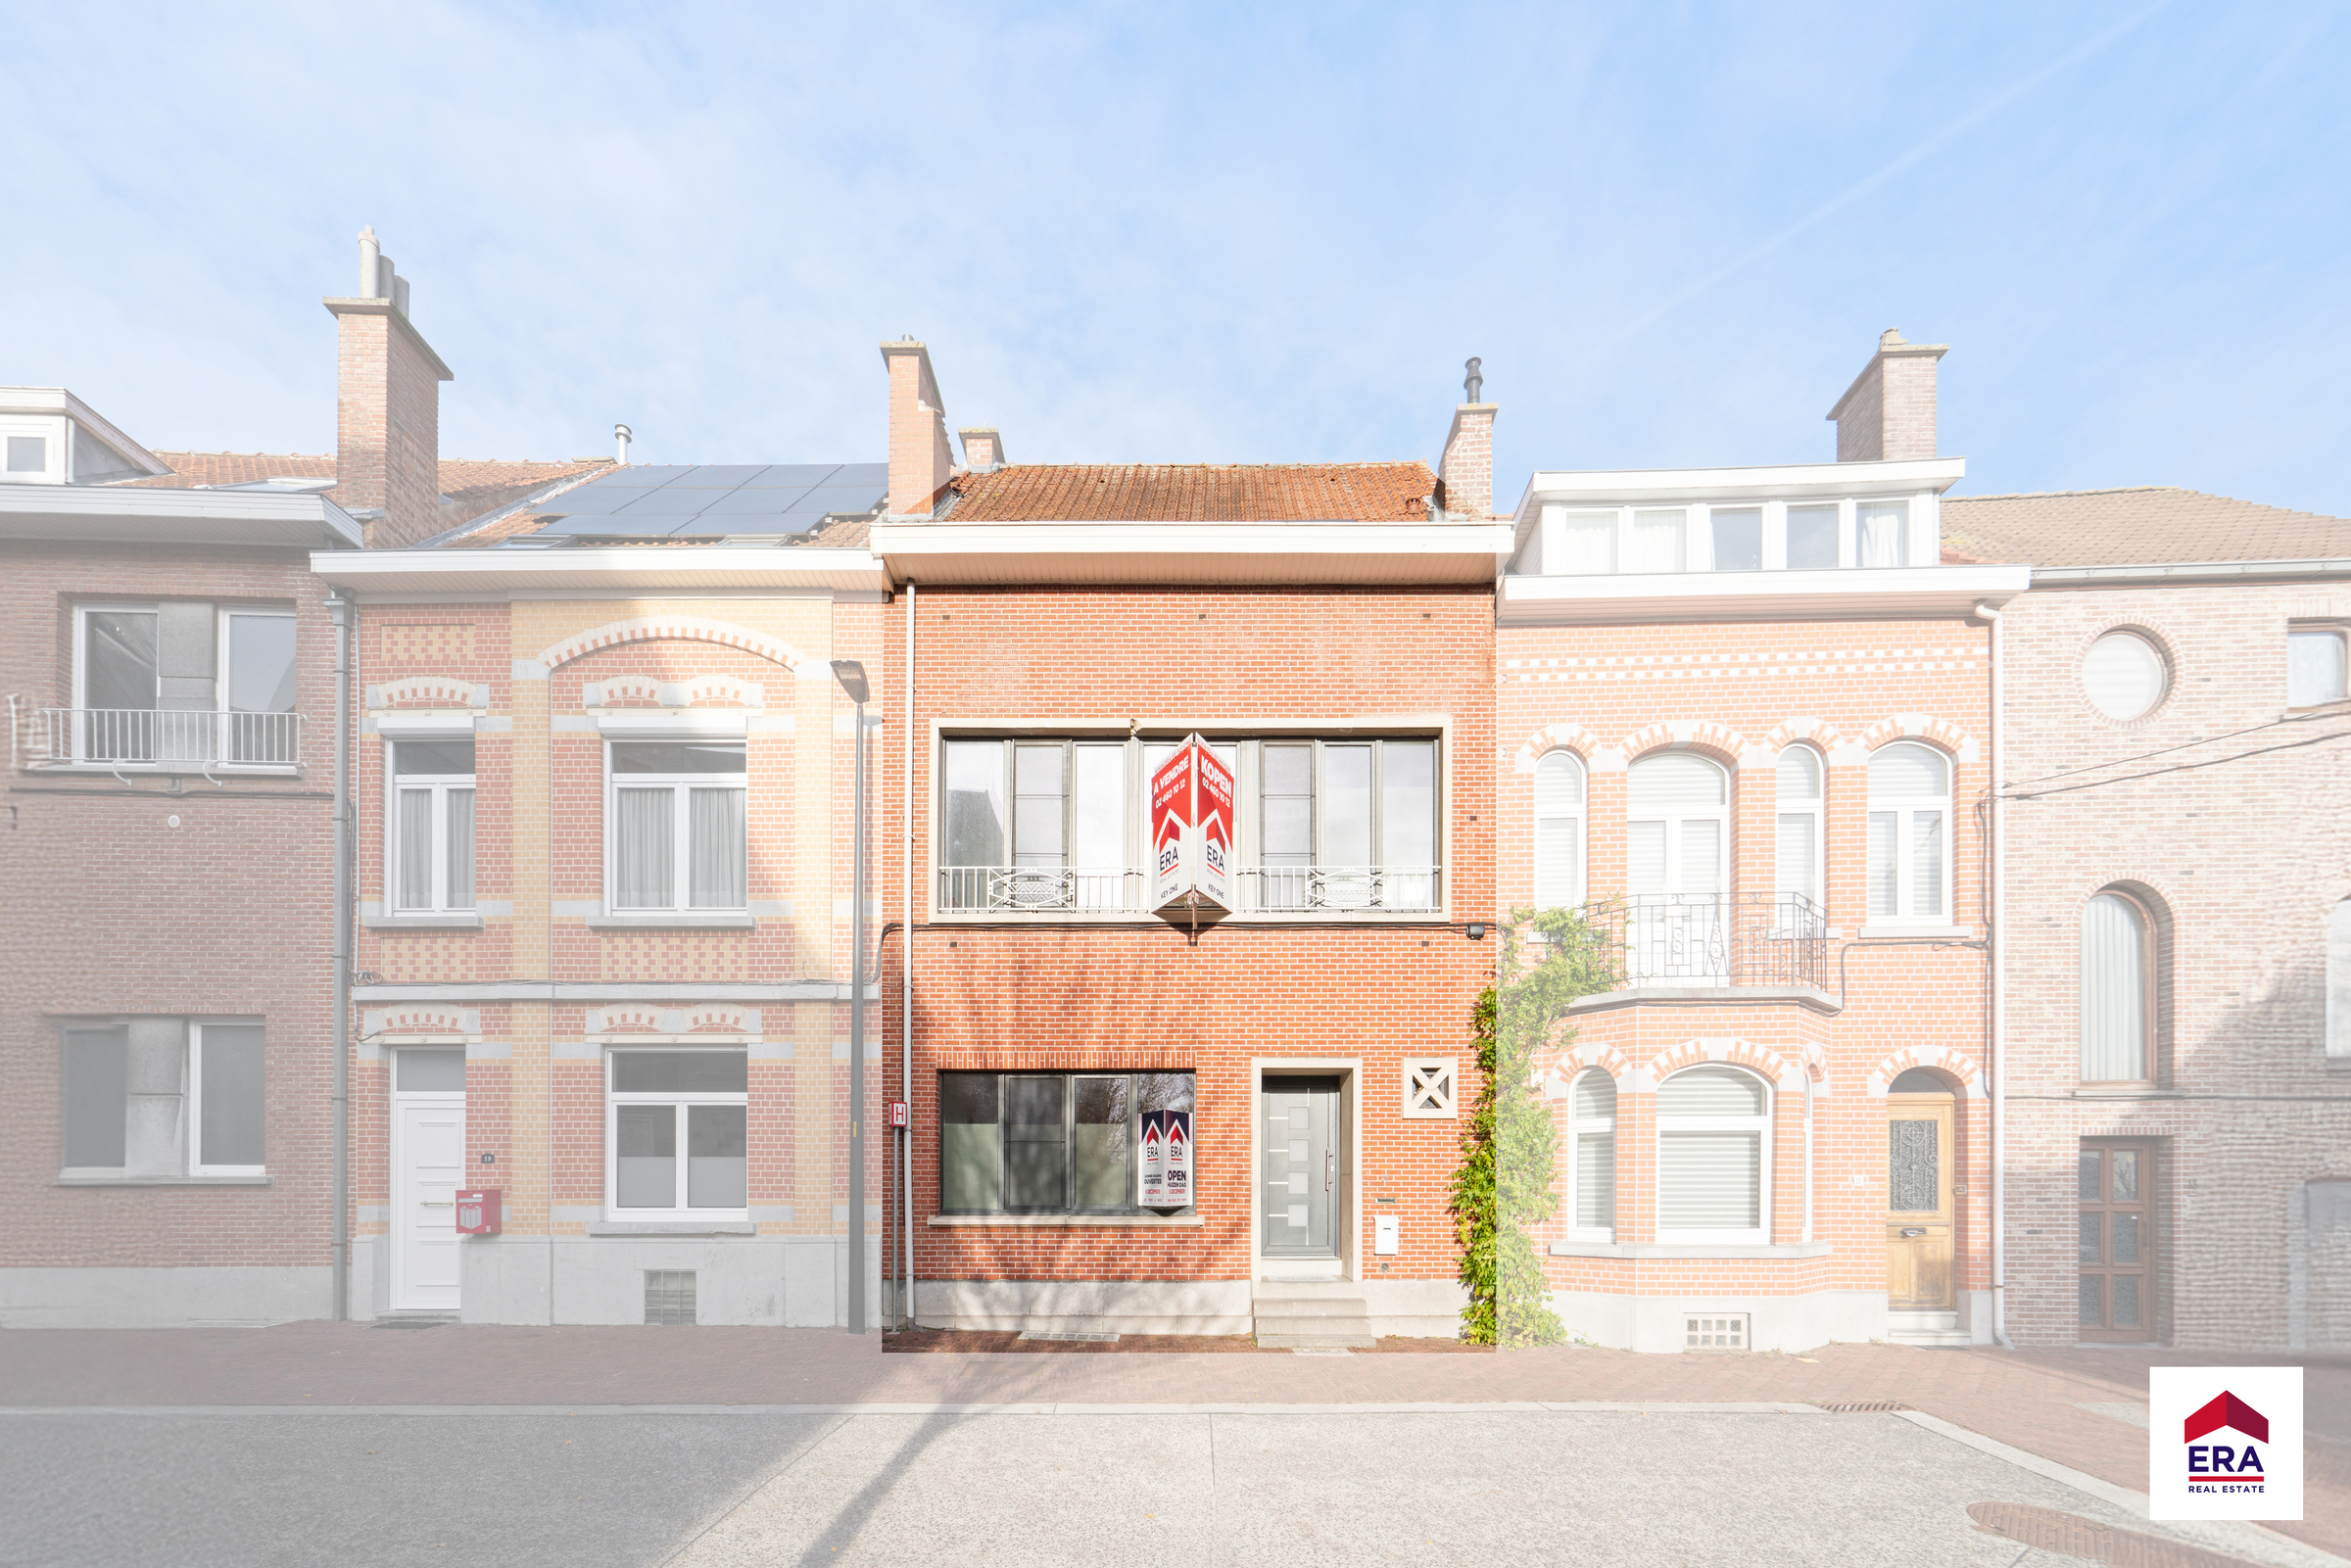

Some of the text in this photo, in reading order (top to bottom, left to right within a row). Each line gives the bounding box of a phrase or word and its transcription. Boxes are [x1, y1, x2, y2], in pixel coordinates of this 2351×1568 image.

[1153, 783, 1159, 796] A
[1160, 755, 1189, 789] VENDRE
[1201, 755, 1231, 798] KOPEN
[1173, 784, 1179, 795] 10
[1219, 791, 1224, 803] 10
[1160, 846, 1178, 872] ERA
[1207, 844, 1224, 871] ERA
[1170, 883, 1178, 894] ONE
[1216, 889, 1224, 899] ONE
[896, 1107, 903, 1121] H
[1147, 1147, 1159, 1157] ERA
[1171, 1146, 1182, 1157] ERA
[1168, 1169, 1186, 1181] OPEN
